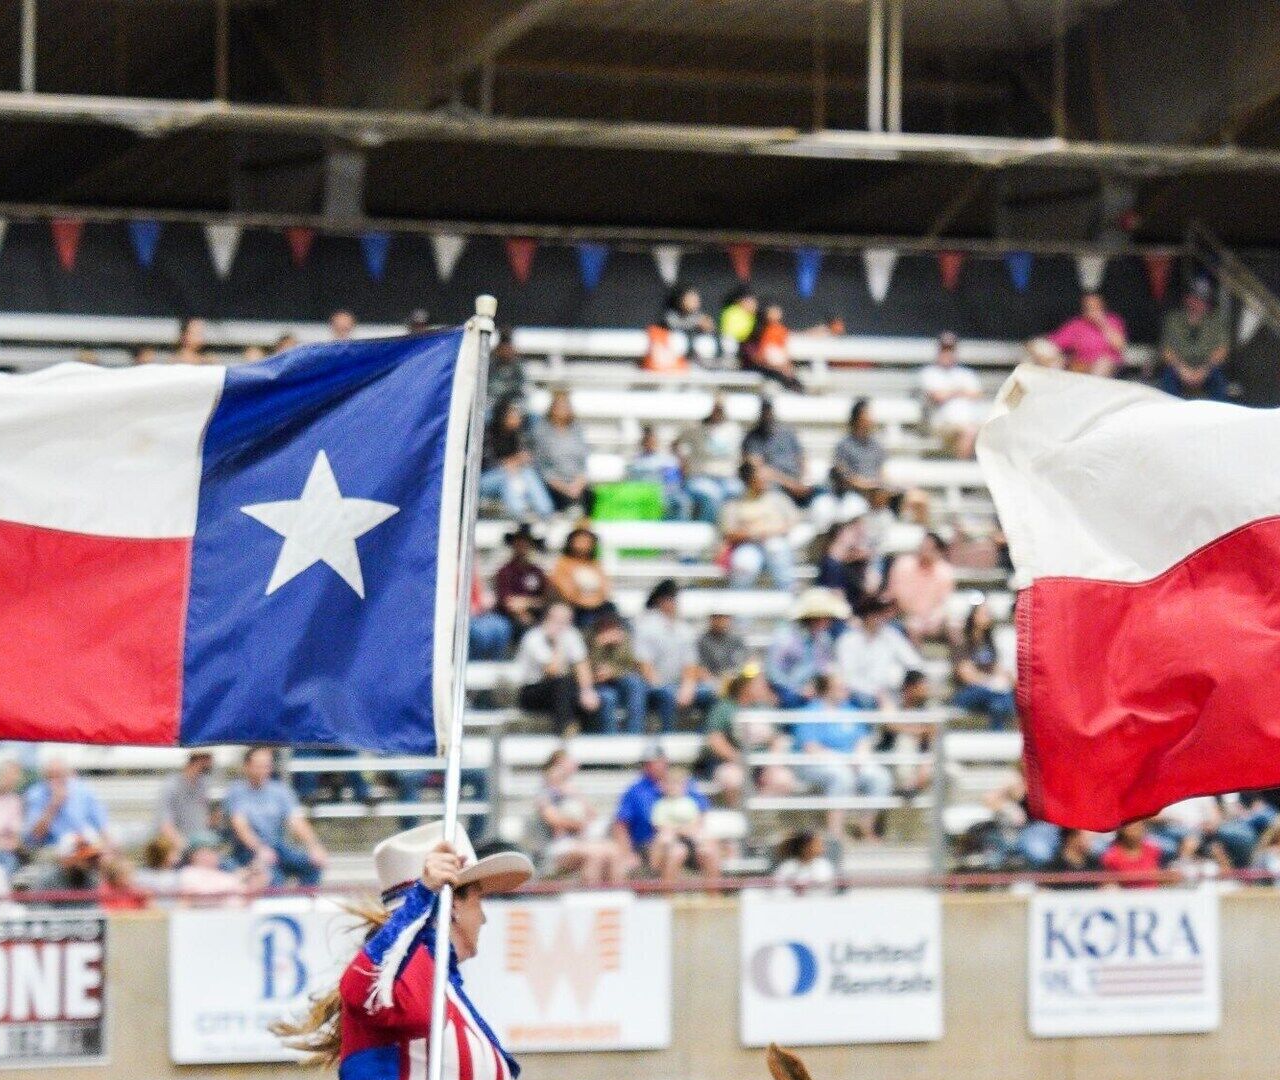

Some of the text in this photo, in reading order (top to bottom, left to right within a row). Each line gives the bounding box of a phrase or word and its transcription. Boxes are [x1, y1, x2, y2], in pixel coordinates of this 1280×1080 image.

[1043, 907, 1201, 959] KORA
[829, 939, 927, 966] United
[829, 973, 933, 997] Rentals
